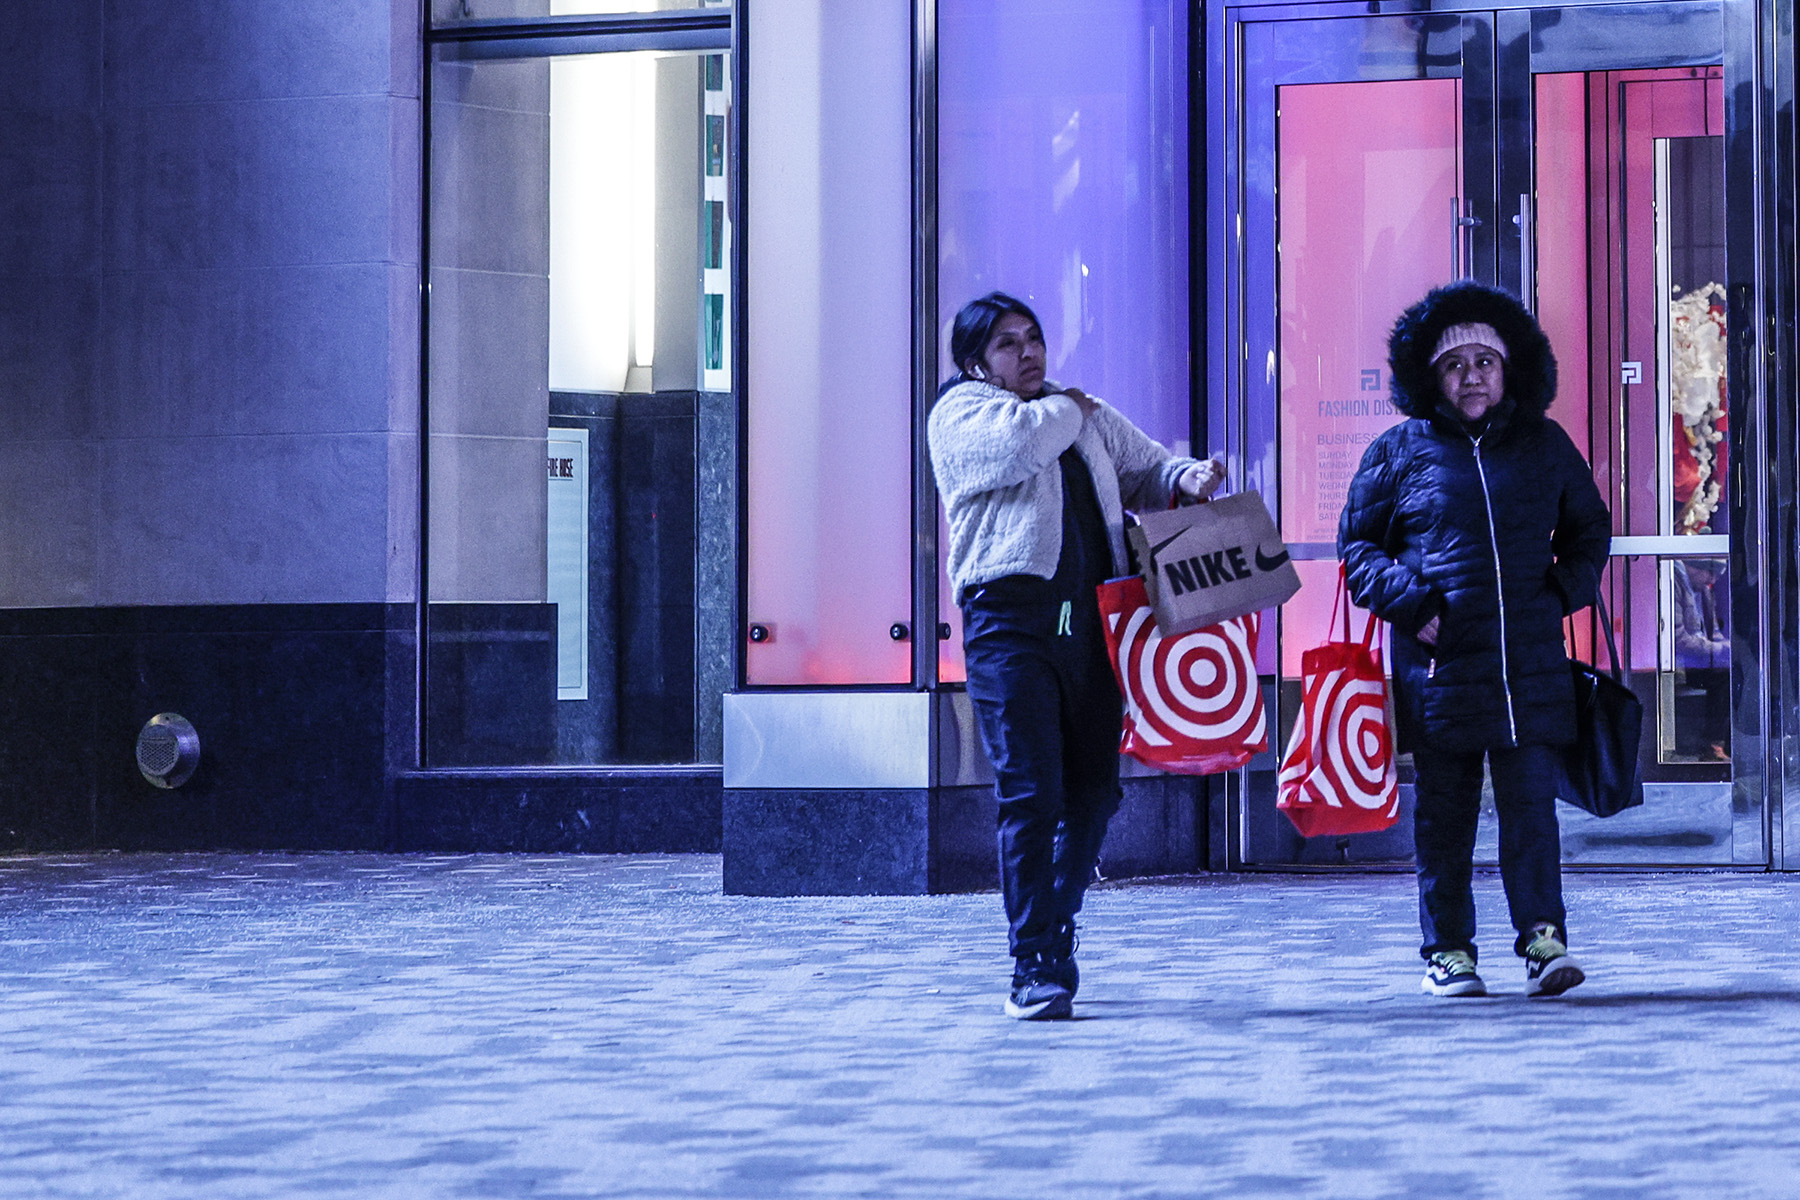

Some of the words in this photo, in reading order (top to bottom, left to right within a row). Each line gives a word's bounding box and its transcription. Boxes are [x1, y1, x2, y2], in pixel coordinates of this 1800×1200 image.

[1318, 400, 1369, 417] FASHION
[1317, 432, 1379, 445] BUSINESS
[1164, 546, 1253, 597] NIKE
